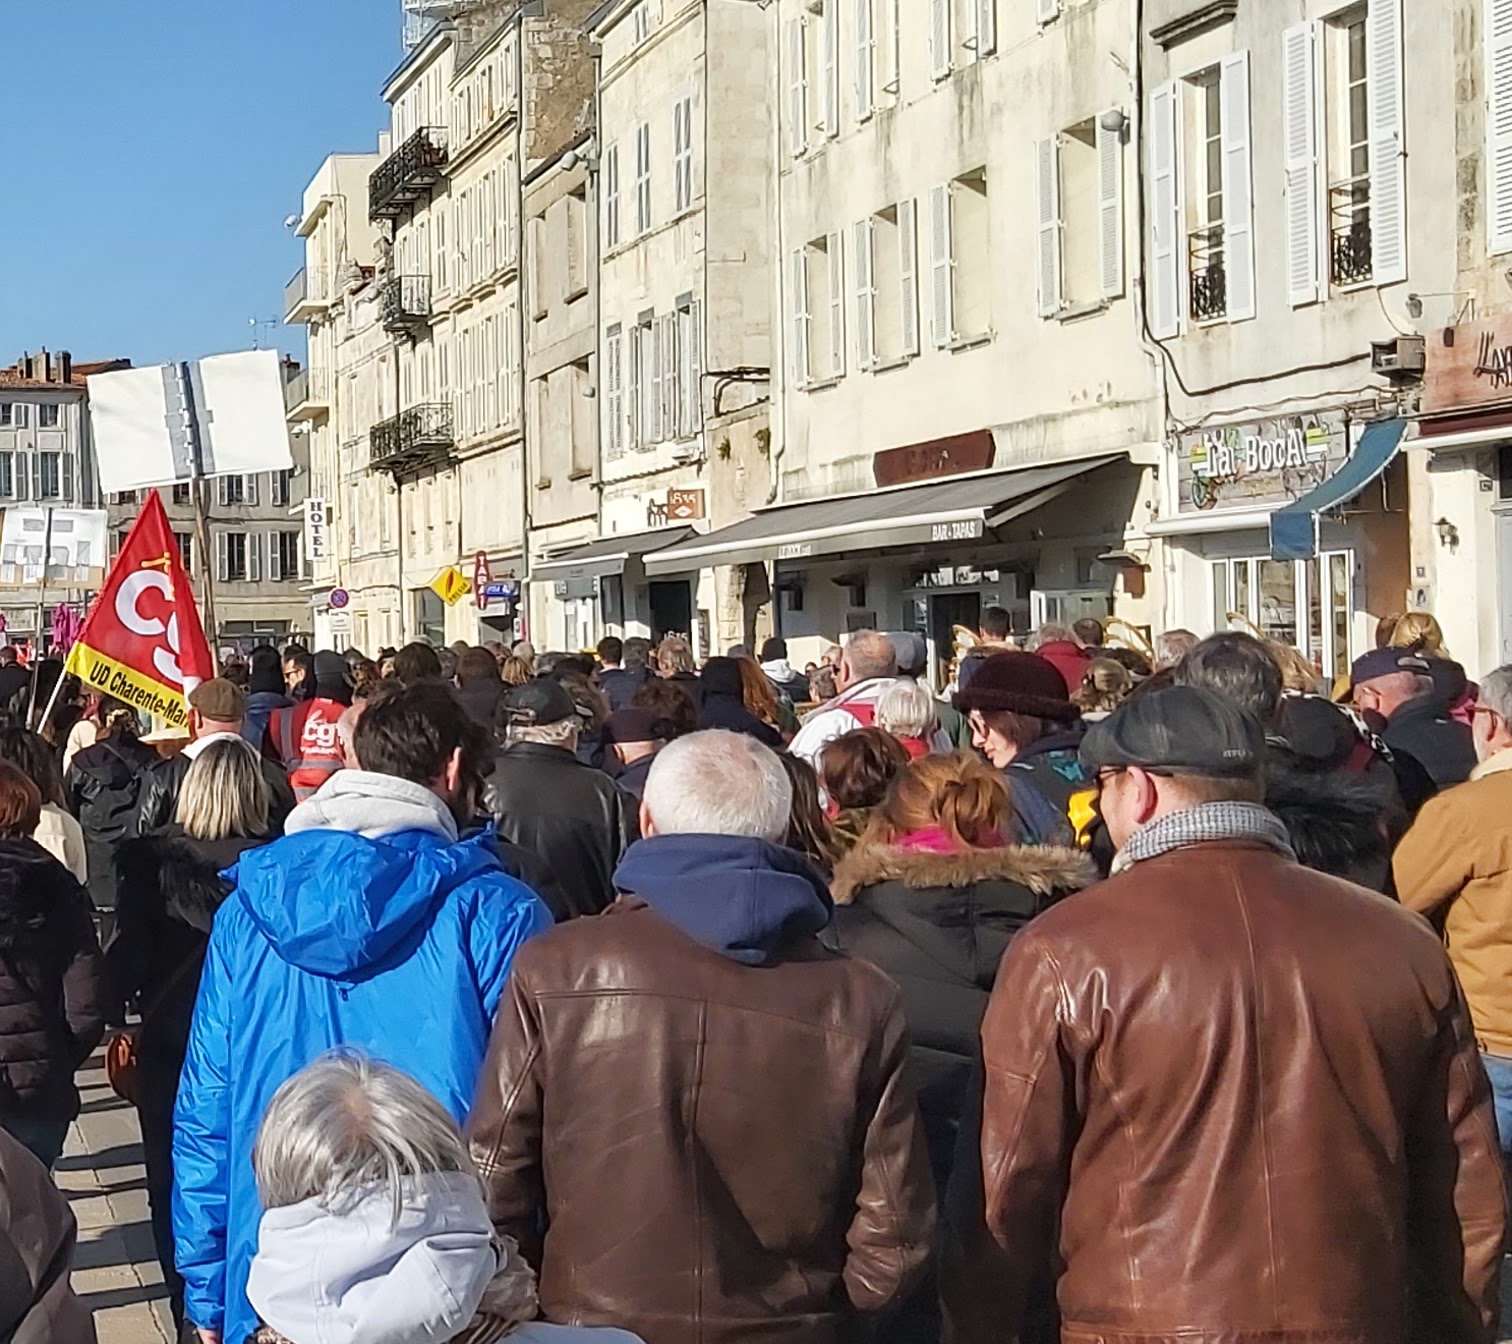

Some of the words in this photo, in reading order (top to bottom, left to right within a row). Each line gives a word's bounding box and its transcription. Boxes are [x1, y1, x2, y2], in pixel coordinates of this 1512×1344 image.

[309, 502, 324, 558] HOTEL
[932, 524, 948, 541] BAR
[952, 520, 976, 539] TAPAS
[89, 660, 111, 686] UD
